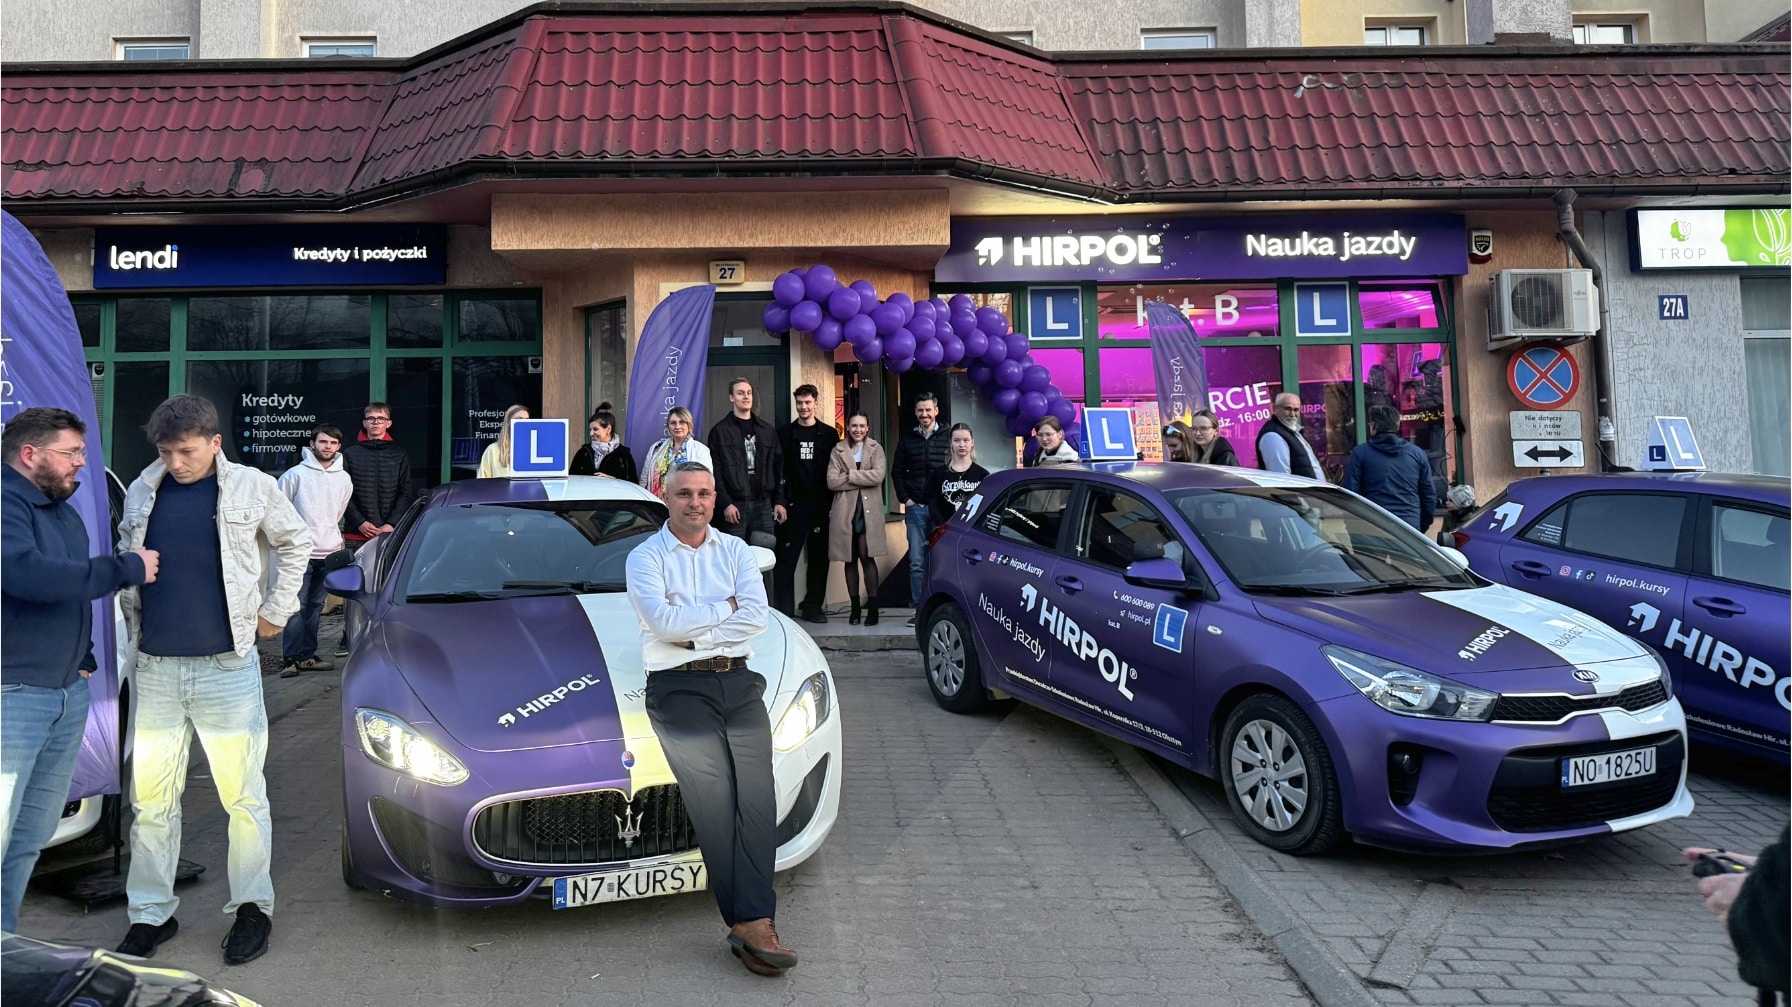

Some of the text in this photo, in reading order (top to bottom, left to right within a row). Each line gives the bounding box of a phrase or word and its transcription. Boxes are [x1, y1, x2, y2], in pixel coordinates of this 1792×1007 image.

[293, 246, 427, 262] Kredyty i pożyczki
[1246, 229, 1417, 262] Nauka jazdy
[1658, 247, 1707, 260] TROP
[110, 244, 178, 270] lendi
[718, 267, 736, 280] 27
[1046, 296, 1069, 330] L
[1215, 294, 1240, 327] B
[1313, 291, 1337, 327] L
[1663, 297, 1685, 318] 27A
[662, 346, 683, 392] jazdy
[241, 393, 304, 410] Kredyty
[252, 413, 316, 426] gotówkowe
[468, 409, 506, 420] Profesjo
[479, 420, 505, 430] Ekspe
[1237, 408, 1271, 424] 16:00
[1538, 415, 1562, 423] dotyczy
[252, 428, 312, 440] hipoteczne
[475, 431, 501, 440] Finan
[1101, 417, 1125, 450] L
[1669, 425, 1695, 460] L
[251, 443, 297, 453] firmowe
[530, 429, 554, 464] L
[1653, 447, 1662, 460] L
[1605, 573, 1671, 596] hirpol.kursy
[978, 591, 1046, 663] Nauka jazdy
[1162, 613, 1176, 643] L
[1575, 671, 1598, 681] KIA
[1573, 758, 1597, 784] NO
[1605, 749, 1653, 780] 1825U
[556, 864, 703, 905] PL N7 KURSY
